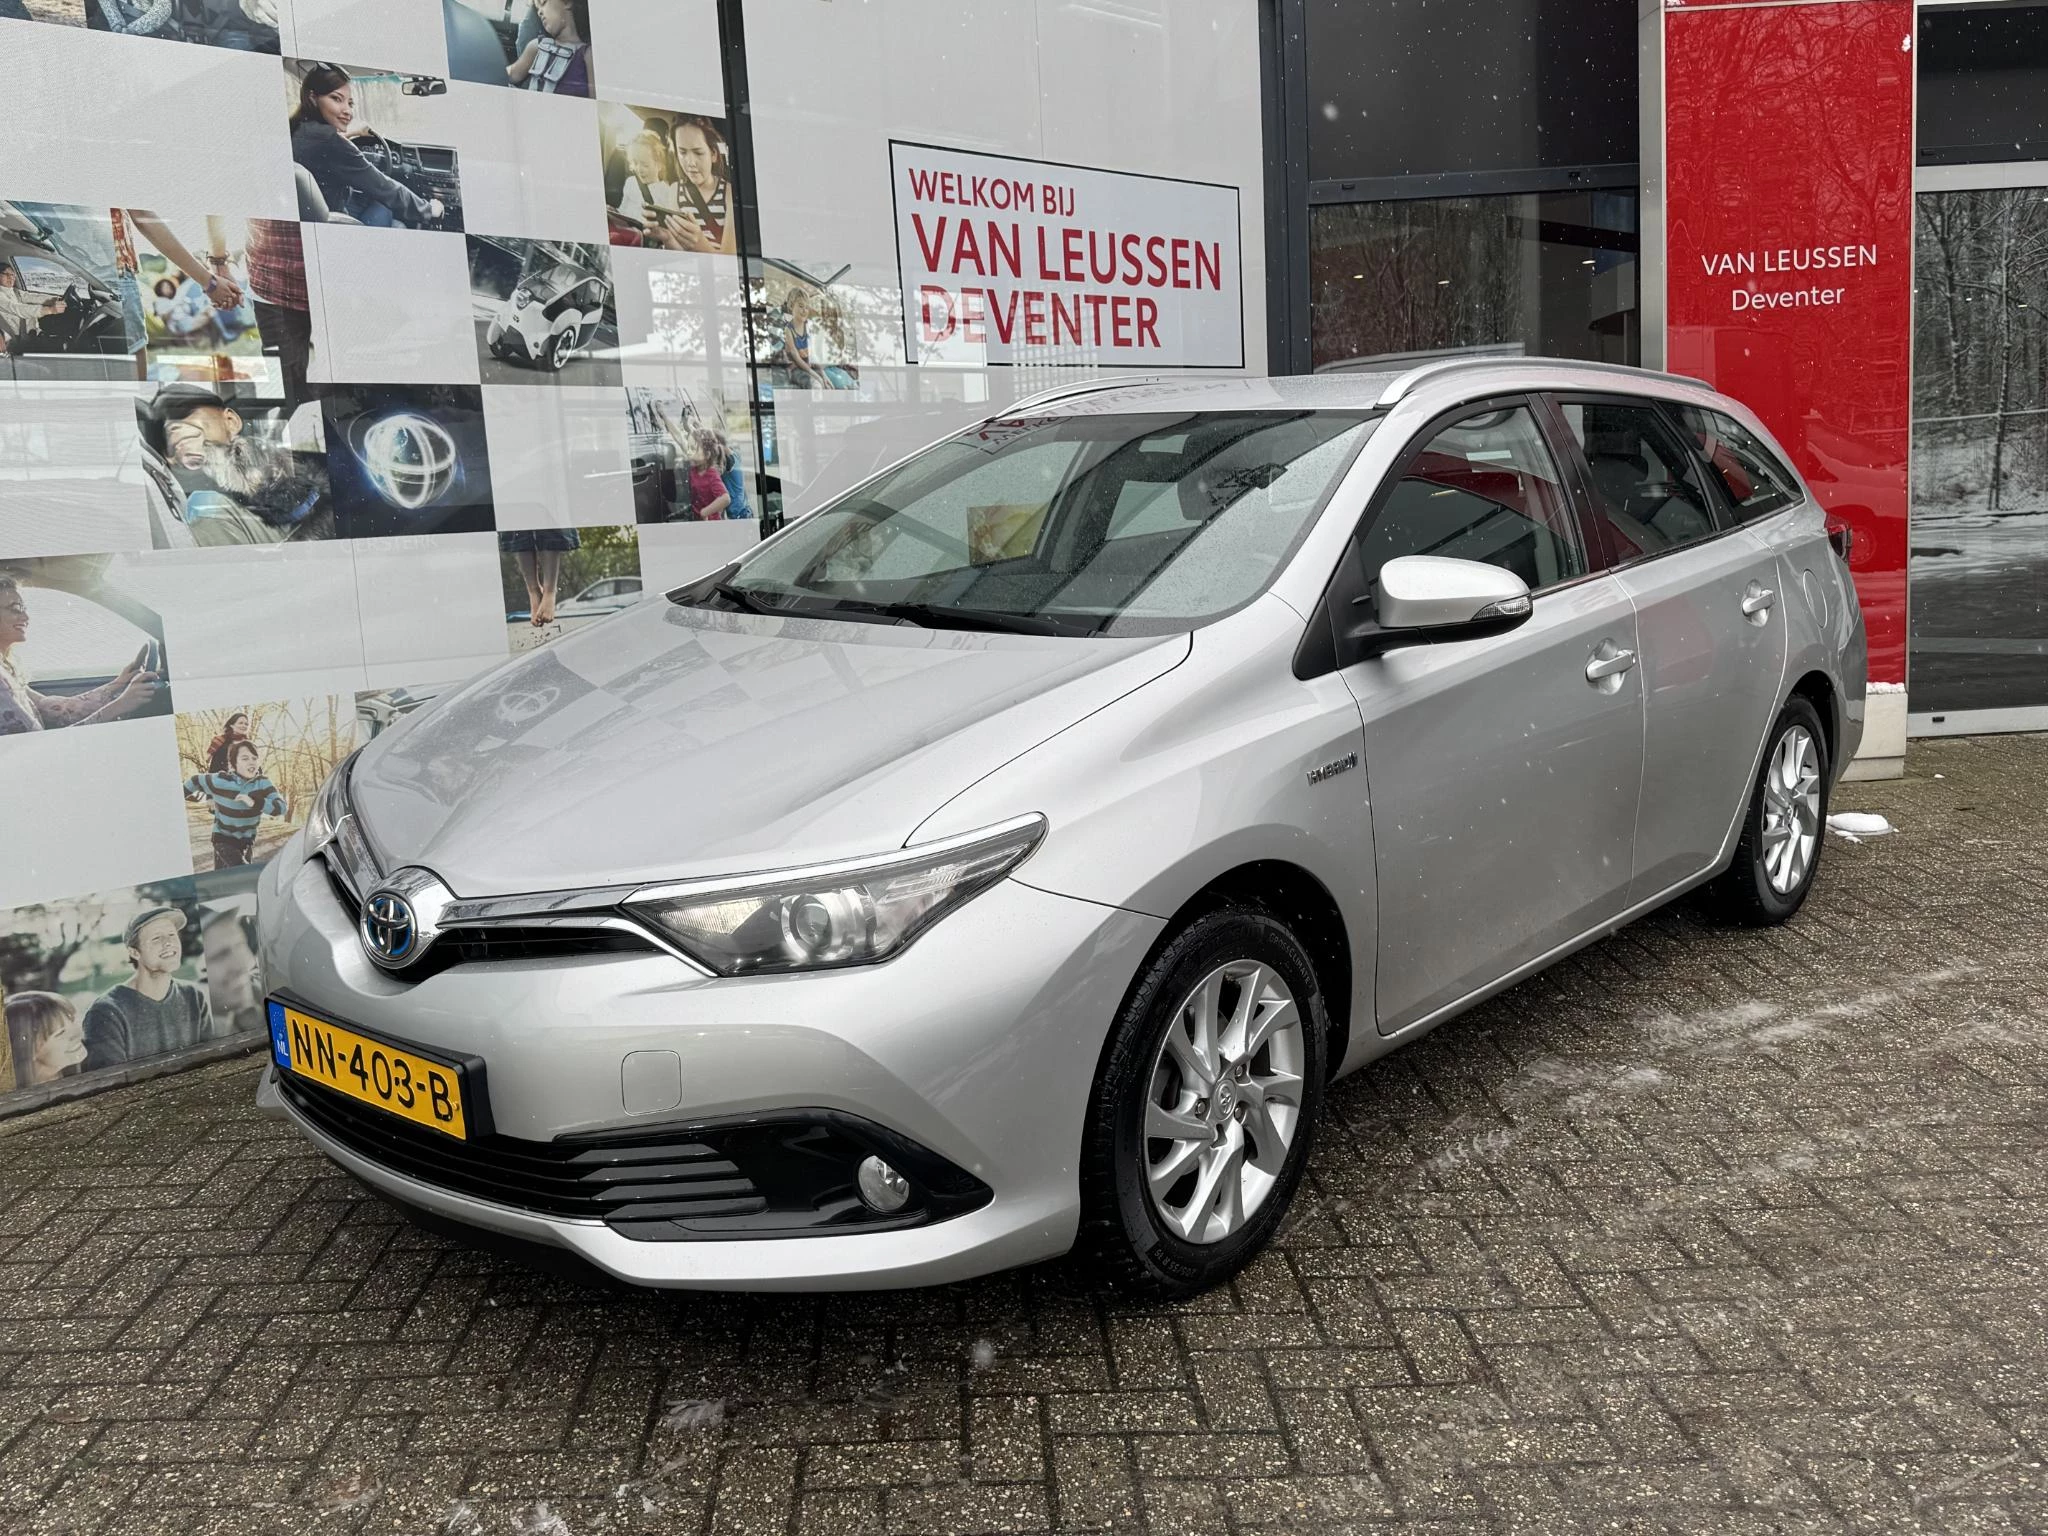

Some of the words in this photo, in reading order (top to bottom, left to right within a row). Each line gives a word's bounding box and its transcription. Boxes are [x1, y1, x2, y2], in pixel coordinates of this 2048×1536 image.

[908, 168, 1035, 213] WELKOM
[1043, 185, 1075, 217] BIJ
[911, 213, 1023, 278] VAN
[1036, 226, 1222, 291] LEUSSEN
[1701, 252, 1755, 276] VAN
[1764, 244, 1877, 272] LEUSSEN
[921, 284, 1162, 348] DEVENTER
[1732, 286, 1845, 311] Deventer
[277, 1039, 289, 1057] NL
[292, 1018, 454, 1122] NN-403-B
